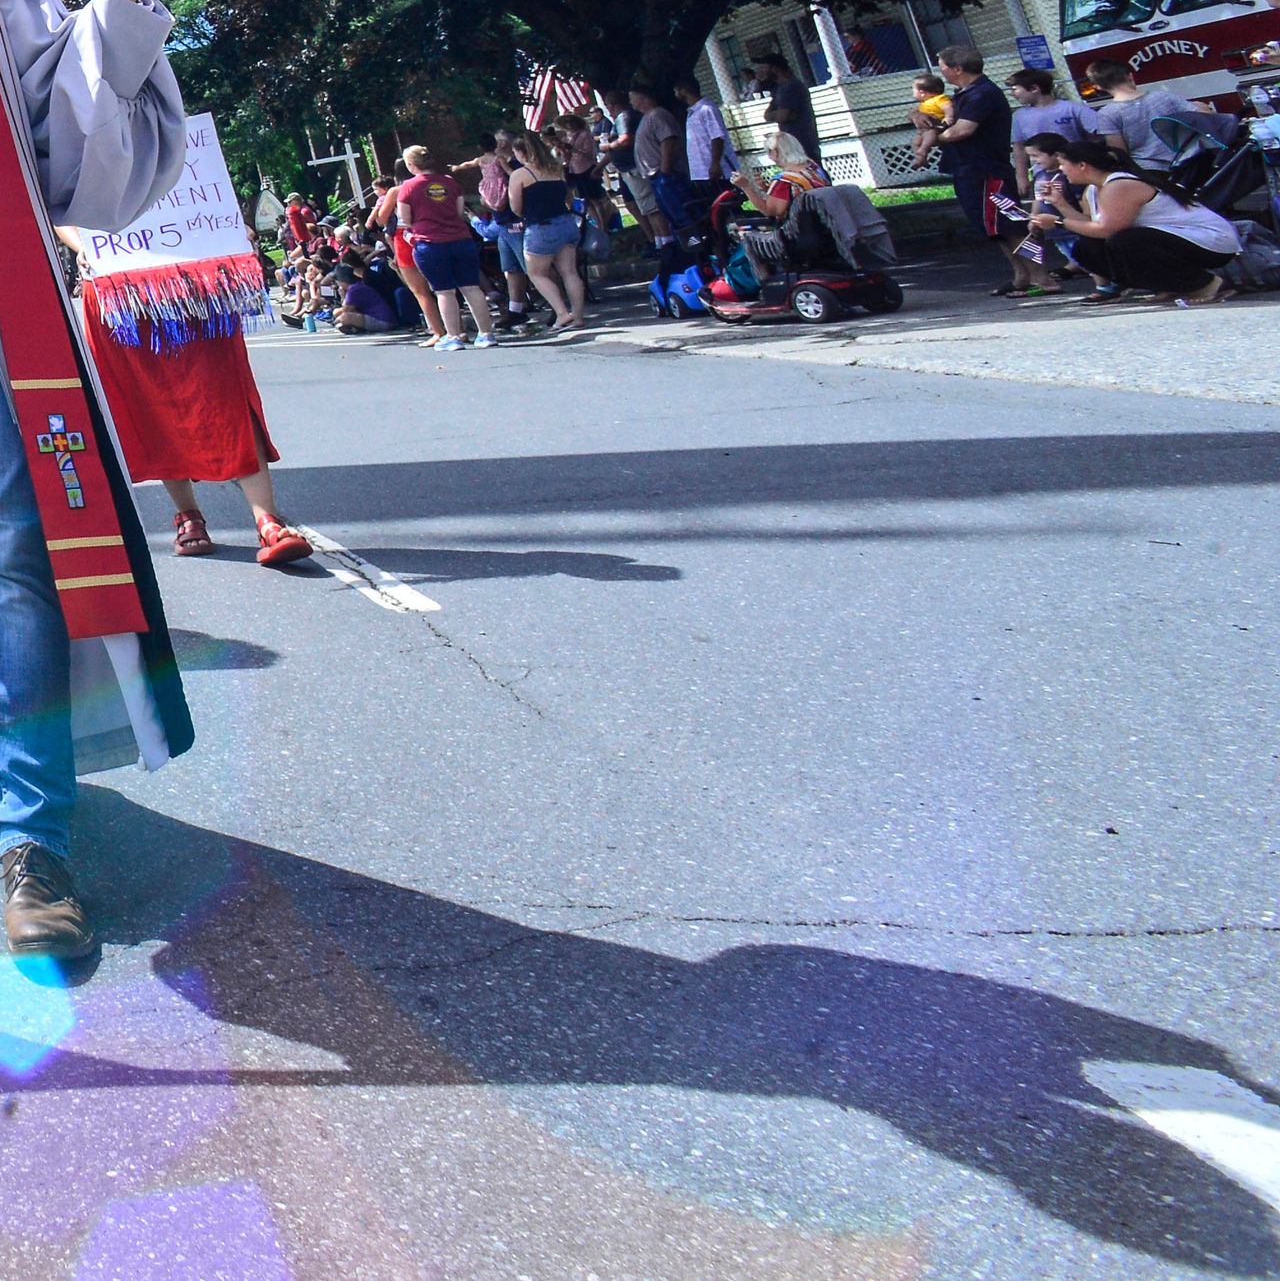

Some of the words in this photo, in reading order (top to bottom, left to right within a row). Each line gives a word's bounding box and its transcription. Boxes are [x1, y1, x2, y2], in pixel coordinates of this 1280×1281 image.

[1128, 40, 1209, 72] PUTNEY
[92, 229, 153, 259] PROP
[160, 223, 182, 248] 5
[203, 212, 239, 232] YES!
